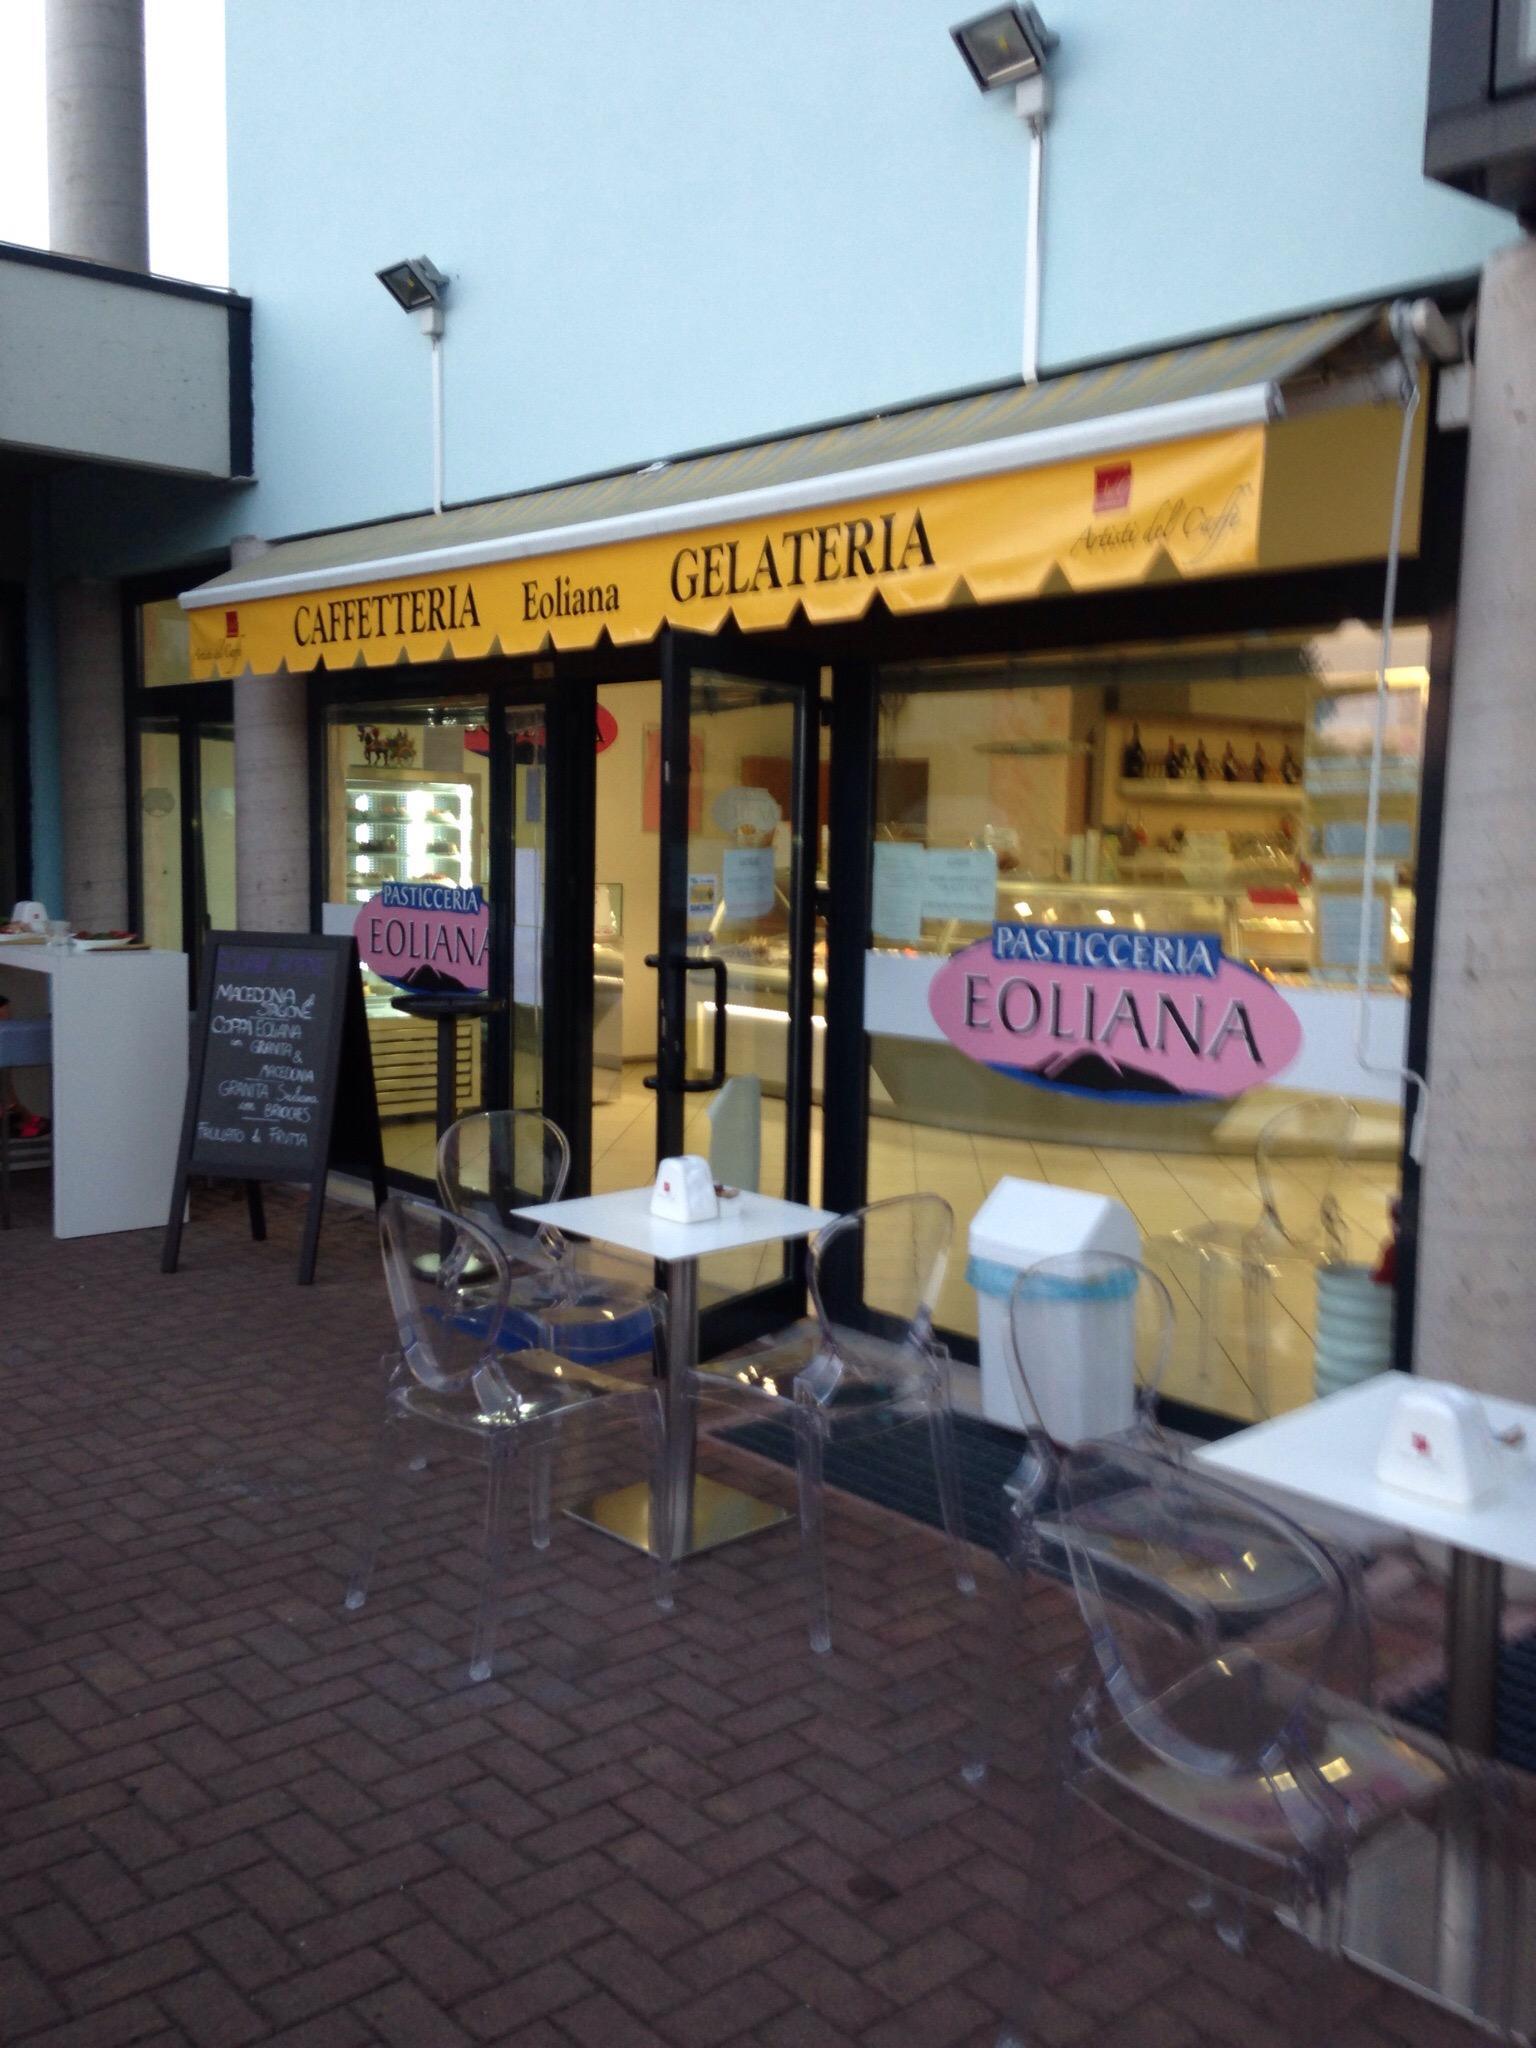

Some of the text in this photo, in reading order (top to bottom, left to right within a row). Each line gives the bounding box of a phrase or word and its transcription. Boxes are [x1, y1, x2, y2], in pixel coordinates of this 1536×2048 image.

[293, 506, 937, 648] CAFFETTERIA Eoliana GELATERIA
[383, 884, 479, 912] PASTICCERIA
[997, 925, 1217, 978] PASTICCERIA
[963, 973, 1267, 1068] EOLIANA
